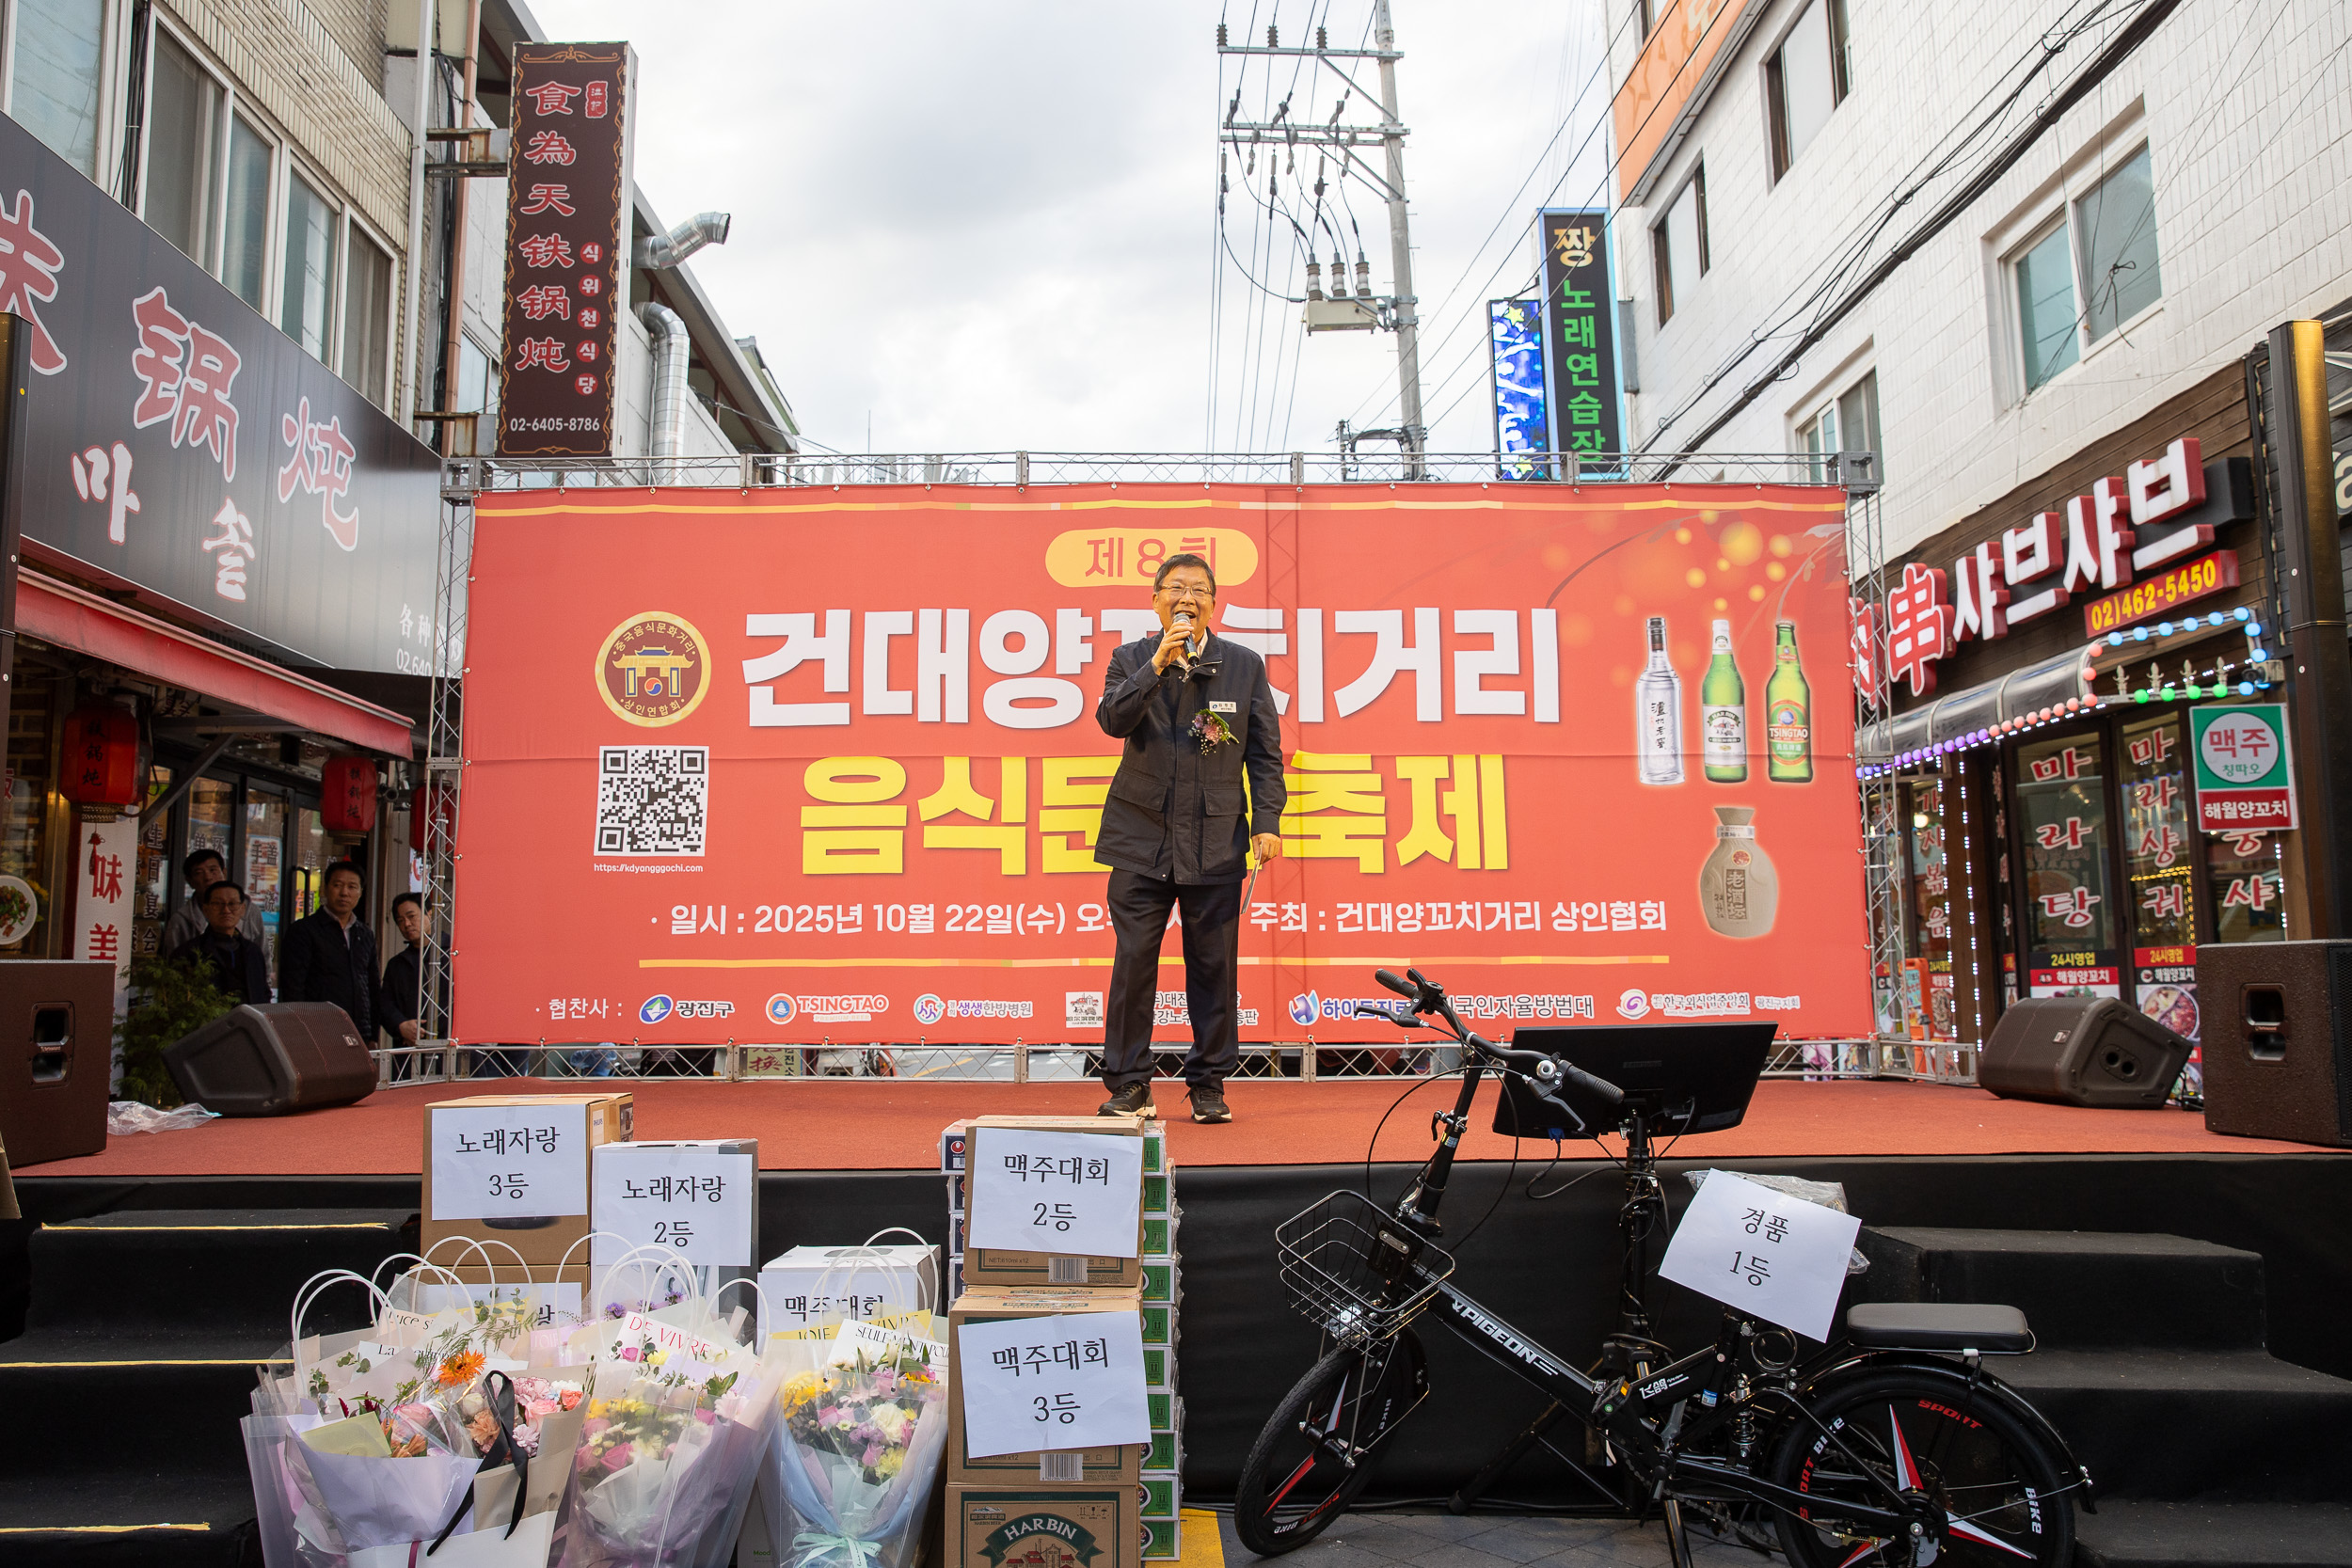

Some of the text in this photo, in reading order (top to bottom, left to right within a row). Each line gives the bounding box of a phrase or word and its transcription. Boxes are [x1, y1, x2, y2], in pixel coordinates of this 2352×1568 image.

[1554, 226, 1597, 268] 짱
[577, 245, 603, 395] 식위천식당
[1560, 279, 1606, 462] 노래연습장
[510, 418, 600, 432] 02-6405-8786
[1953, 437, 2215, 641] 샤브샤브
[2090, 559, 2217, 631] 02)462-5450
[614, 622, 695, 653] 중국음식문화거리
[624, 699, 681, 717] 상인연합회
[1769, 727, 1808, 738] TSINGTAO
[2209, 729, 2269, 758] 맥주
[2204, 800, 2288, 819] 해월양꼬치
[2030, 748, 2102, 928] 마라탕
[671, 903, 1113, 935] 일시 2025년 10월 22일(수) 오
[1249, 901, 1666, 933] 주최 건대양꼬치거리 상인협회
[2051, 952, 2096, 966] 24시영업
[2057, 970, 2110, 984] 해월양꼬치
[549, 998, 609, 1020] 협찬사
[675, 1001, 735, 1017] 광진구
[799, 996, 888, 1012] TSINGTAO
[958, 1001, 1032, 1017] 생생한방병원
[1449, 996, 1594, 1019] 국인자율방범대
[1663, 993, 1750, 1008] 한국외식업중앙회
[455, 1126, 561, 1156] 노래자랑
[1004, 1154, 1109, 1186] 맥주대회
[488, 1173, 530, 1199] 3등
[622, 1176, 726, 1203] 노래자랑
[1033, 1203, 1077, 1231] 2등
[1740, 1206, 1788, 1244] 경품
[654, 1221, 694, 1247] 2등
[1728, 1250, 1772, 1287] 1등
[1460, 1307, 1537, 1363] PIGEON
[993, 1338, 1109, 1377] 맥주대회
[1034, 1393, 1081, 1424] 3등
[1003, 1517, 1078, 1541] HARBIN
